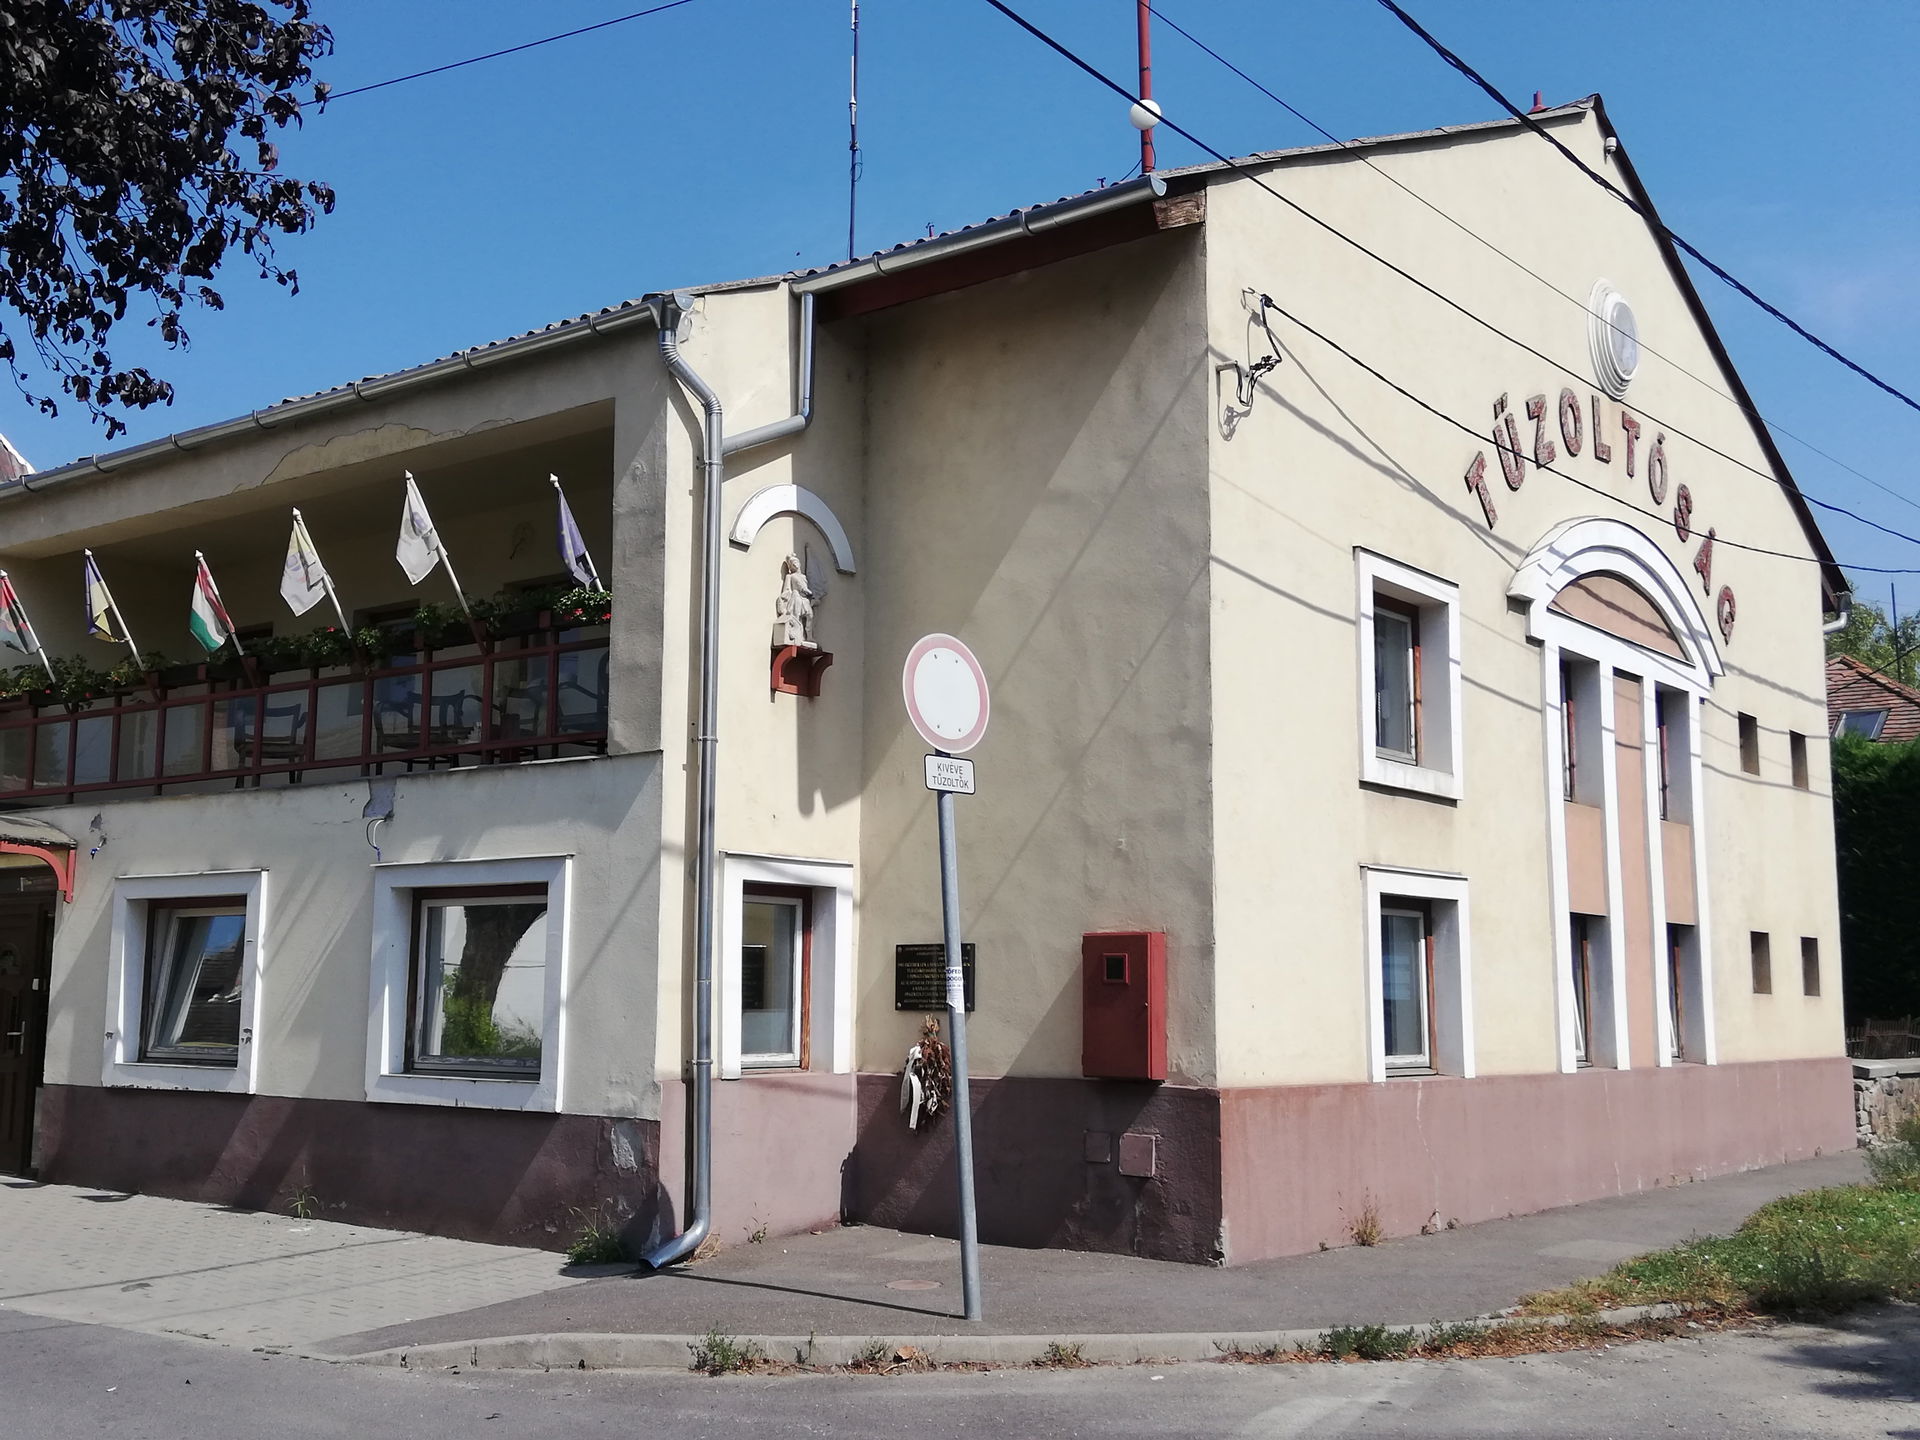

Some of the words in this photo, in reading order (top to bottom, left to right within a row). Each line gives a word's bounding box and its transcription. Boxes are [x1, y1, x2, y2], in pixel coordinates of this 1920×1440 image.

[1464, 387, 1736, 647] TŰZOLTÓSÁG
[937, 761, 964, 775] KIVÉVE
[932, 773, 969, 789] TŰZOLTÓK
